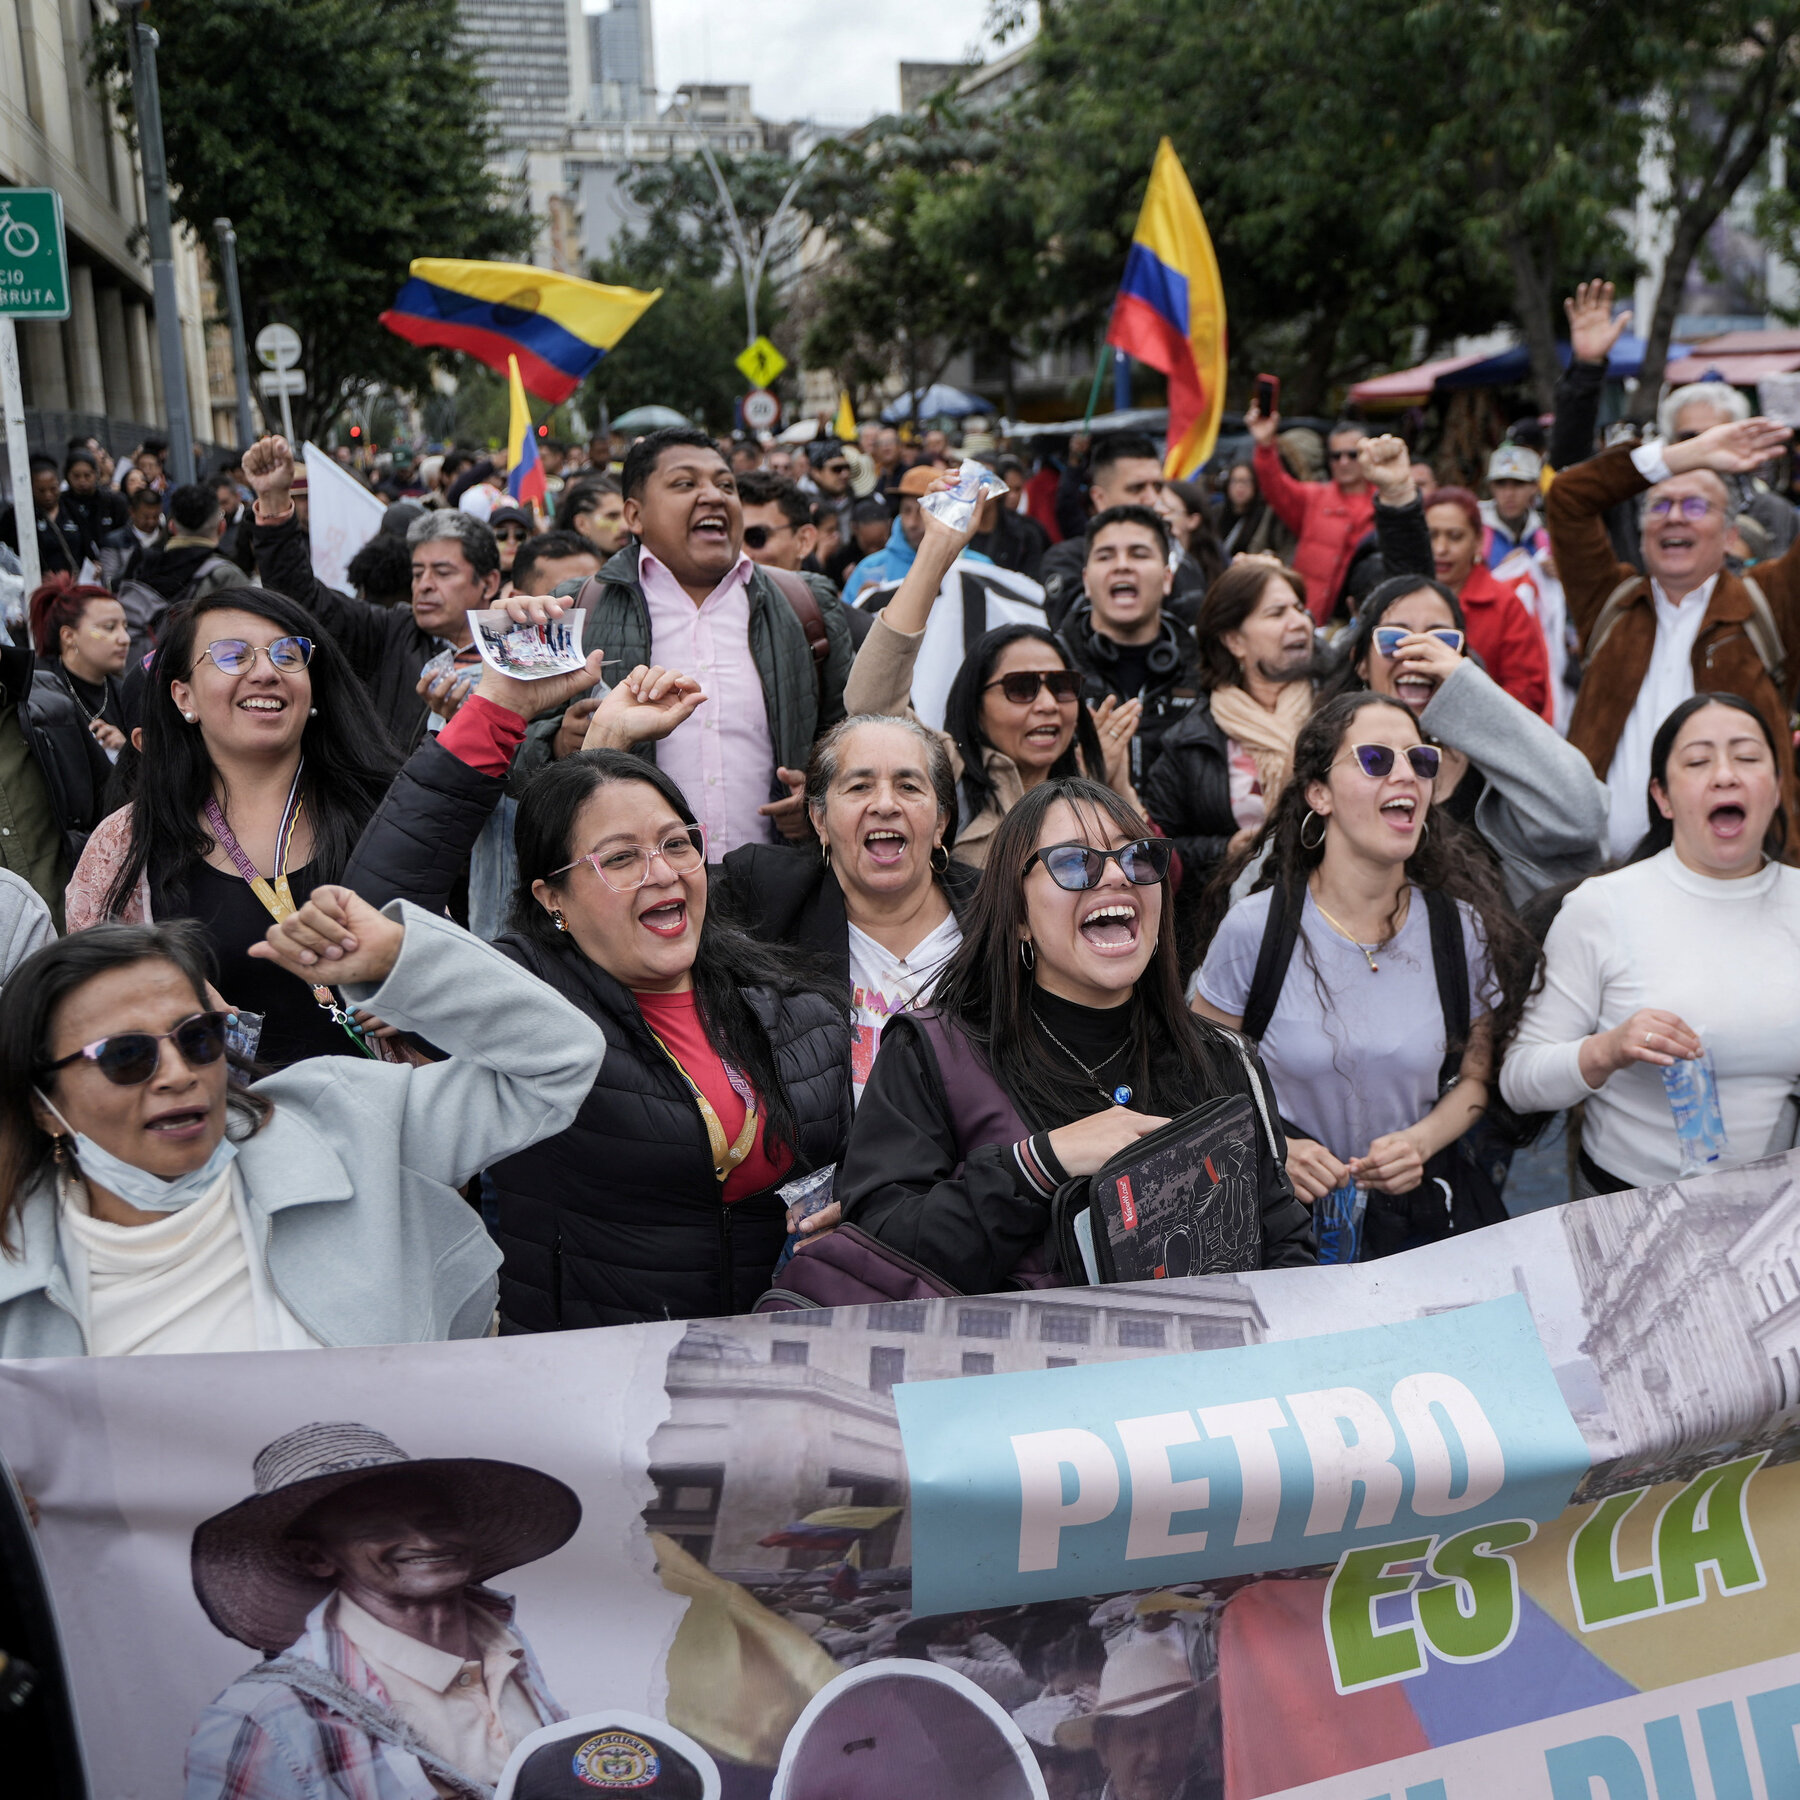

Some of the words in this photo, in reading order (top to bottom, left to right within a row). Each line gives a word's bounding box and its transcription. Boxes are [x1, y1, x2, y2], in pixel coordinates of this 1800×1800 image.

[1010, 1372, 1505, 1573] PETRO
[1322, 1518, 1538, 1695] ES
[1567, 1448, 1768, 1632] LA
